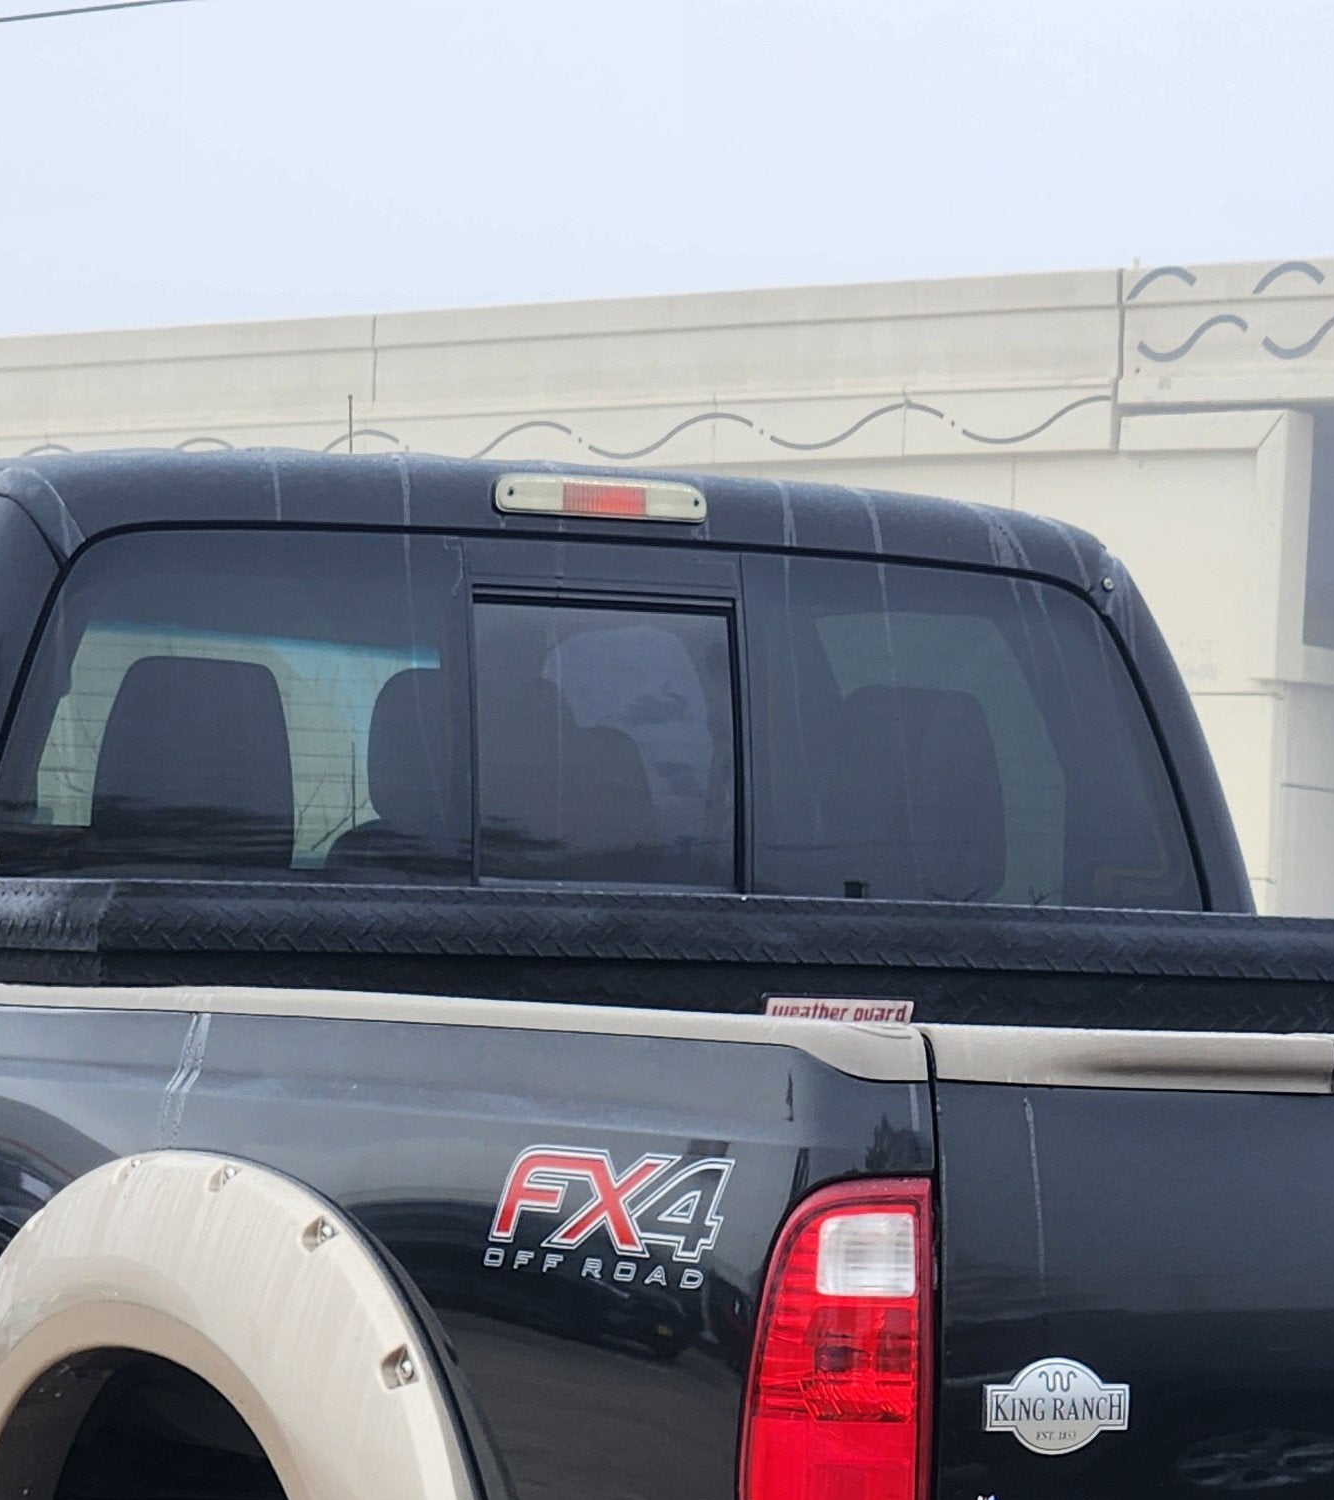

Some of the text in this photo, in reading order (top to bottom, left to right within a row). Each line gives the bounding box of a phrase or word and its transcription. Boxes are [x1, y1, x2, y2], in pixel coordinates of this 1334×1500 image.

[771, 1002, 850, 1021] weather
[488, 1144, 736, 1264] FX4
[483, 1247, 705, 1290] OFF ROAD
[993, 1393, 1124, 1422] KING RANCH
